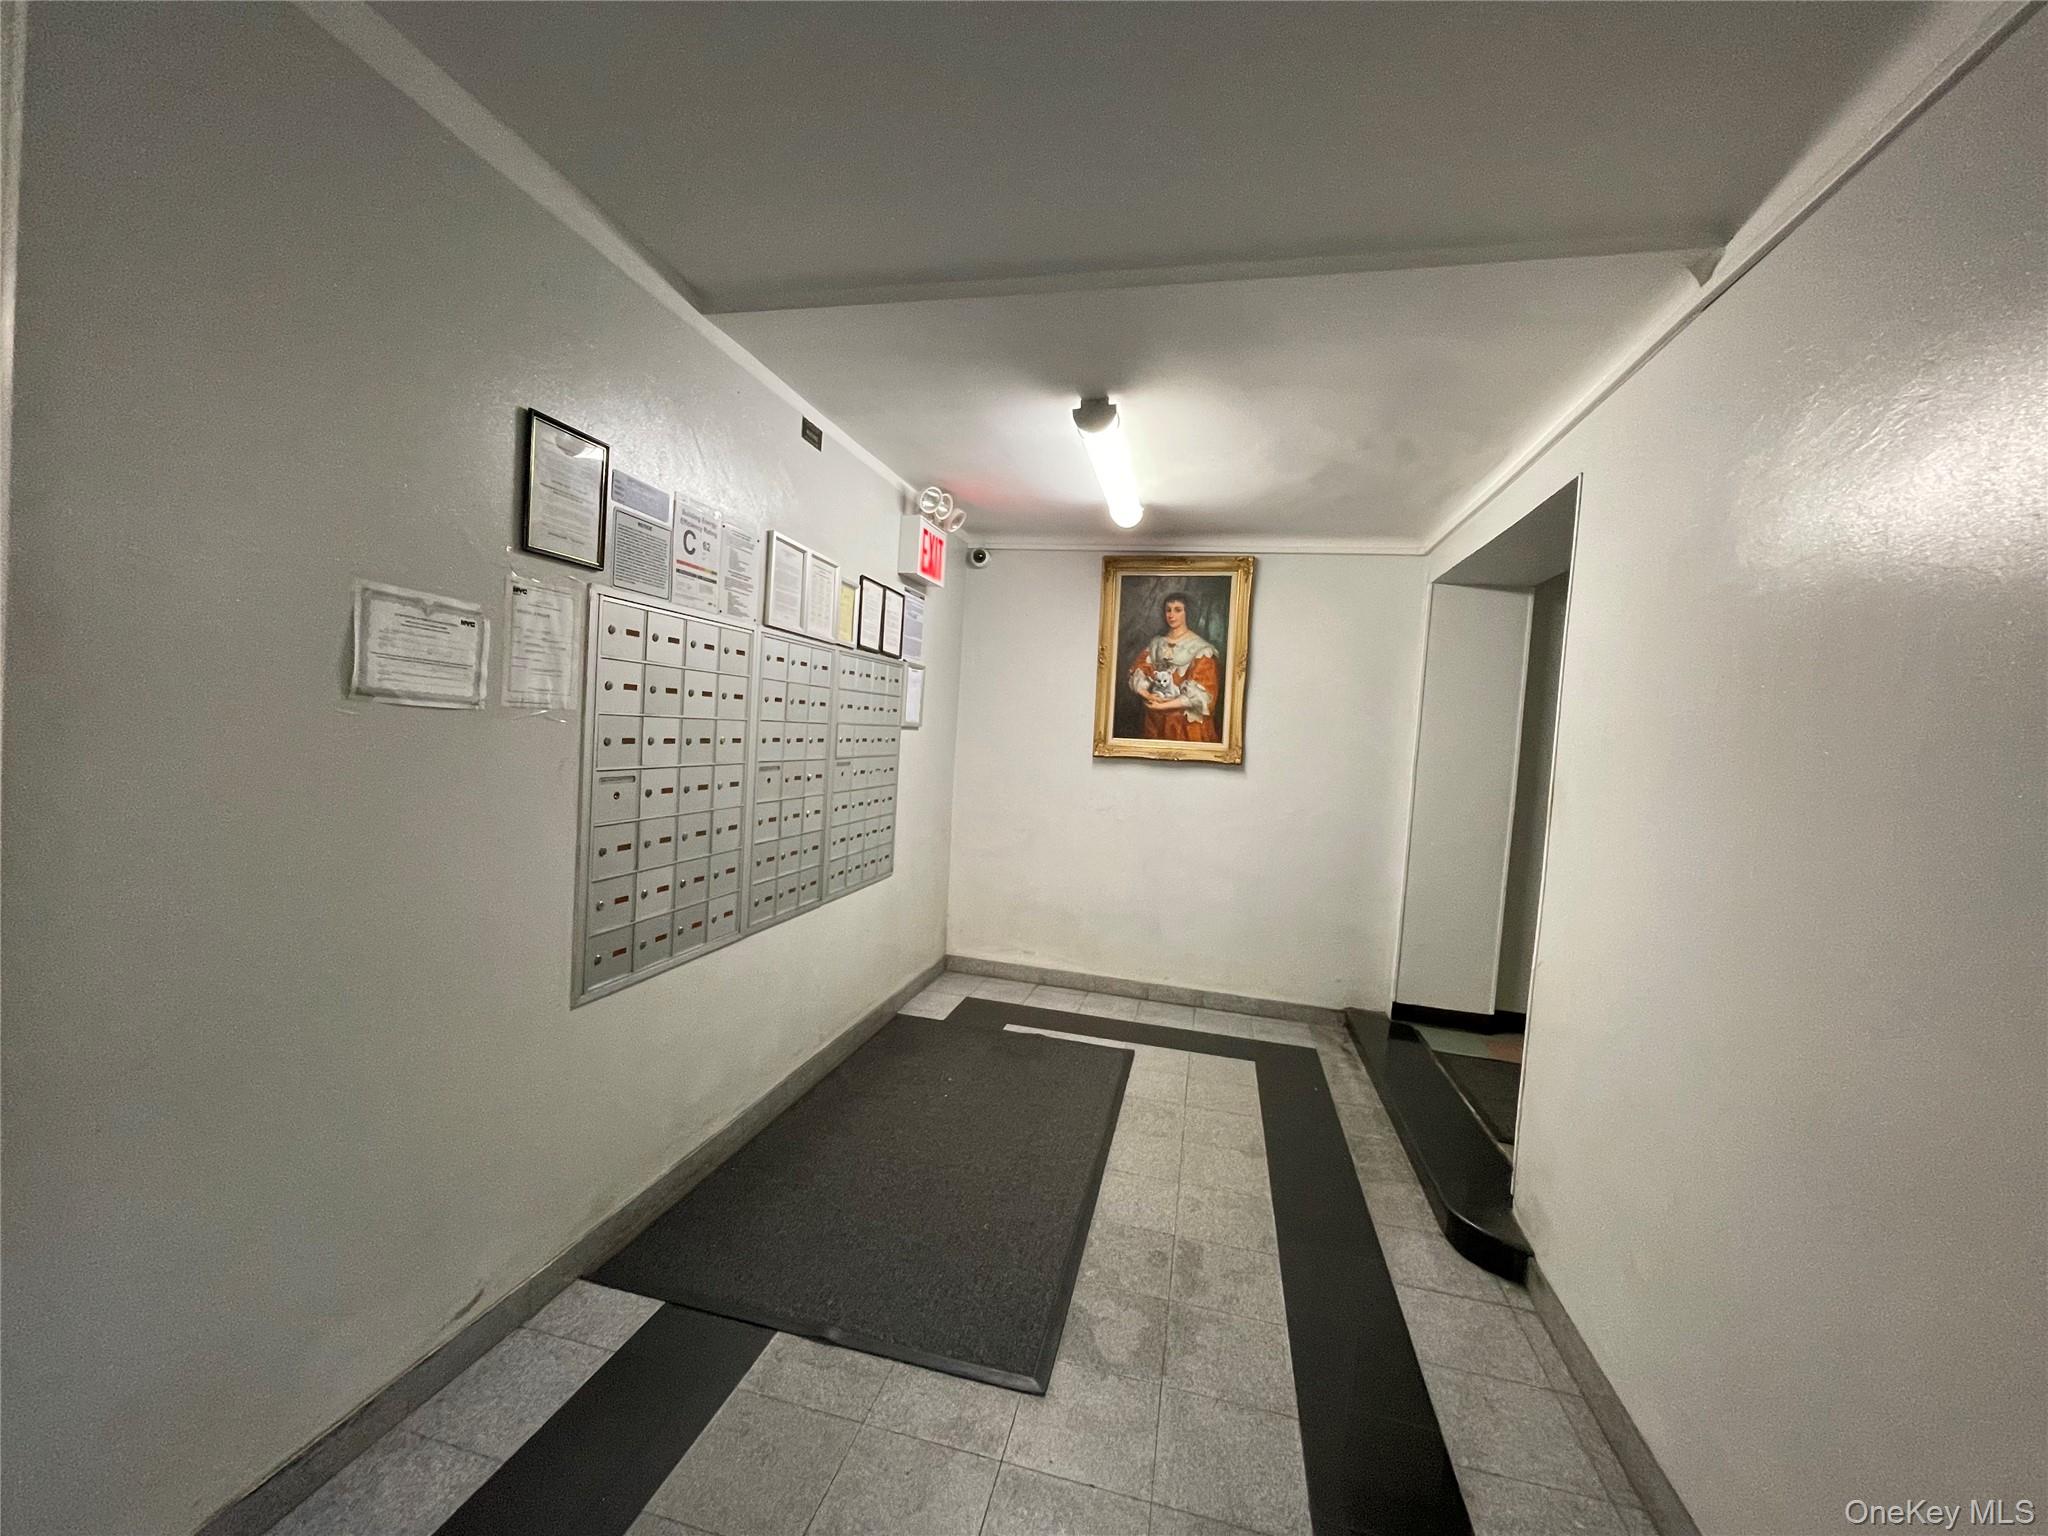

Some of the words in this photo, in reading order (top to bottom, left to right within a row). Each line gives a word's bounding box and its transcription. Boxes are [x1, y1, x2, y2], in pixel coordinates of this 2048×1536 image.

[683, 530, 697, 555] C
[921, 527, 943, 582] EXIT
[512, 585, 528, 595] NYC
[460, 619, 476, 628] NYC
